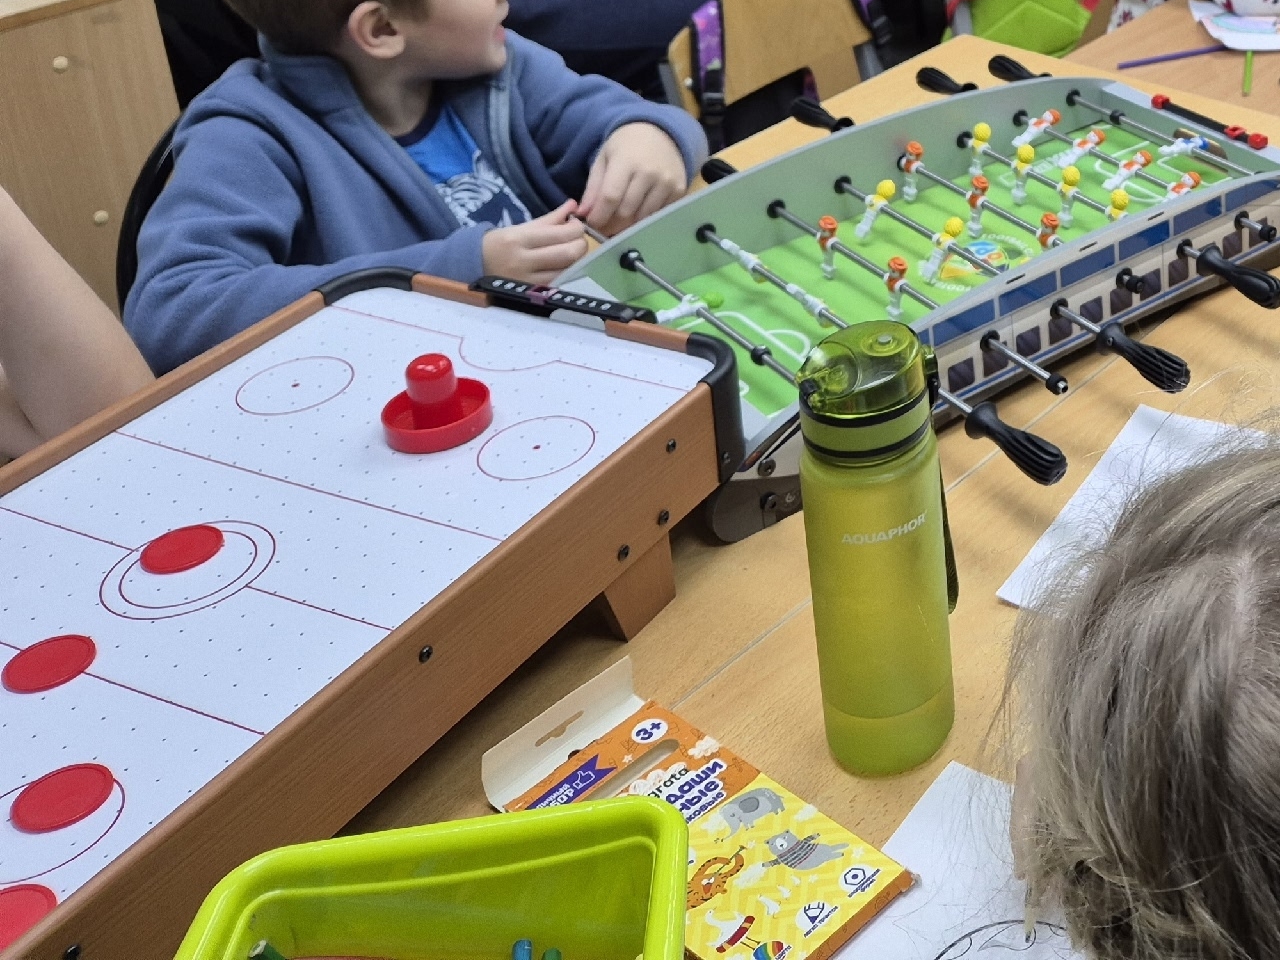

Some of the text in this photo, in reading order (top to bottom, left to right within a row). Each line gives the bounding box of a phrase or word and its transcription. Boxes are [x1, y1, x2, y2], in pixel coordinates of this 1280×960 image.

[841, 512, 926, 545] AQUAPHOR
[635, 721, 662, 741] 3+
[648, 768, 689, 798] grata
